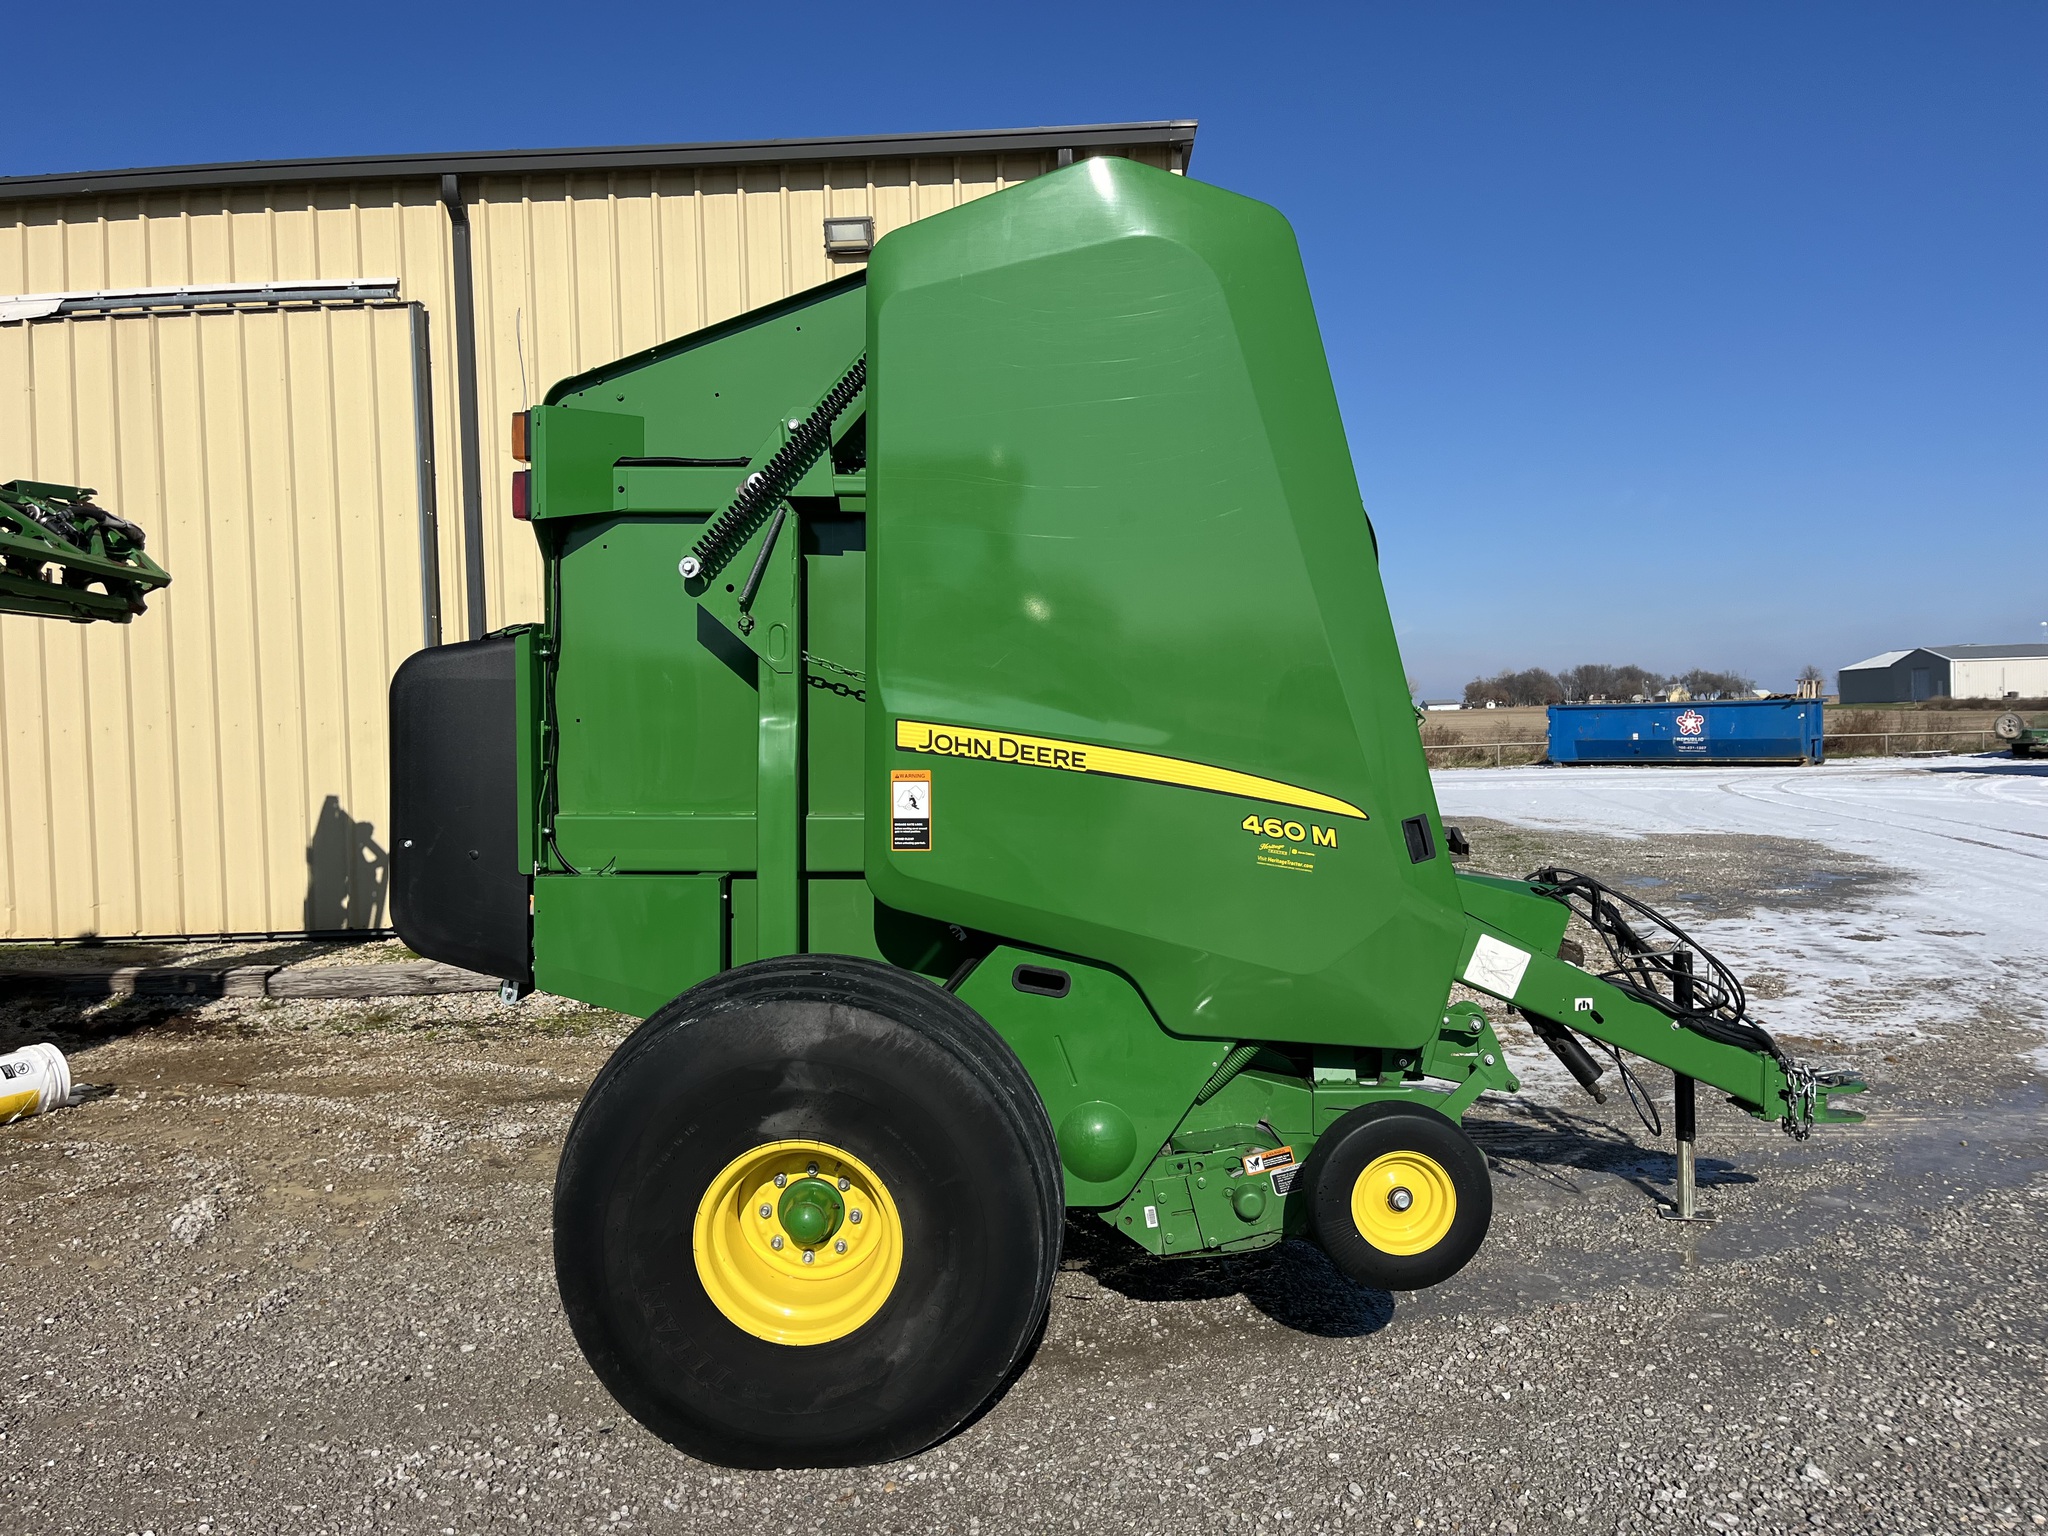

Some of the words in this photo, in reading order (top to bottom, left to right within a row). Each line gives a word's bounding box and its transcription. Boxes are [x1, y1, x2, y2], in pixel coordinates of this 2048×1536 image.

[918, 729, 991, 757] JOHN
[999, 737, 1087, 769] DEERE
[1241, 814, 1307, 842] 460
[1310, 824, 1339, 849] M
